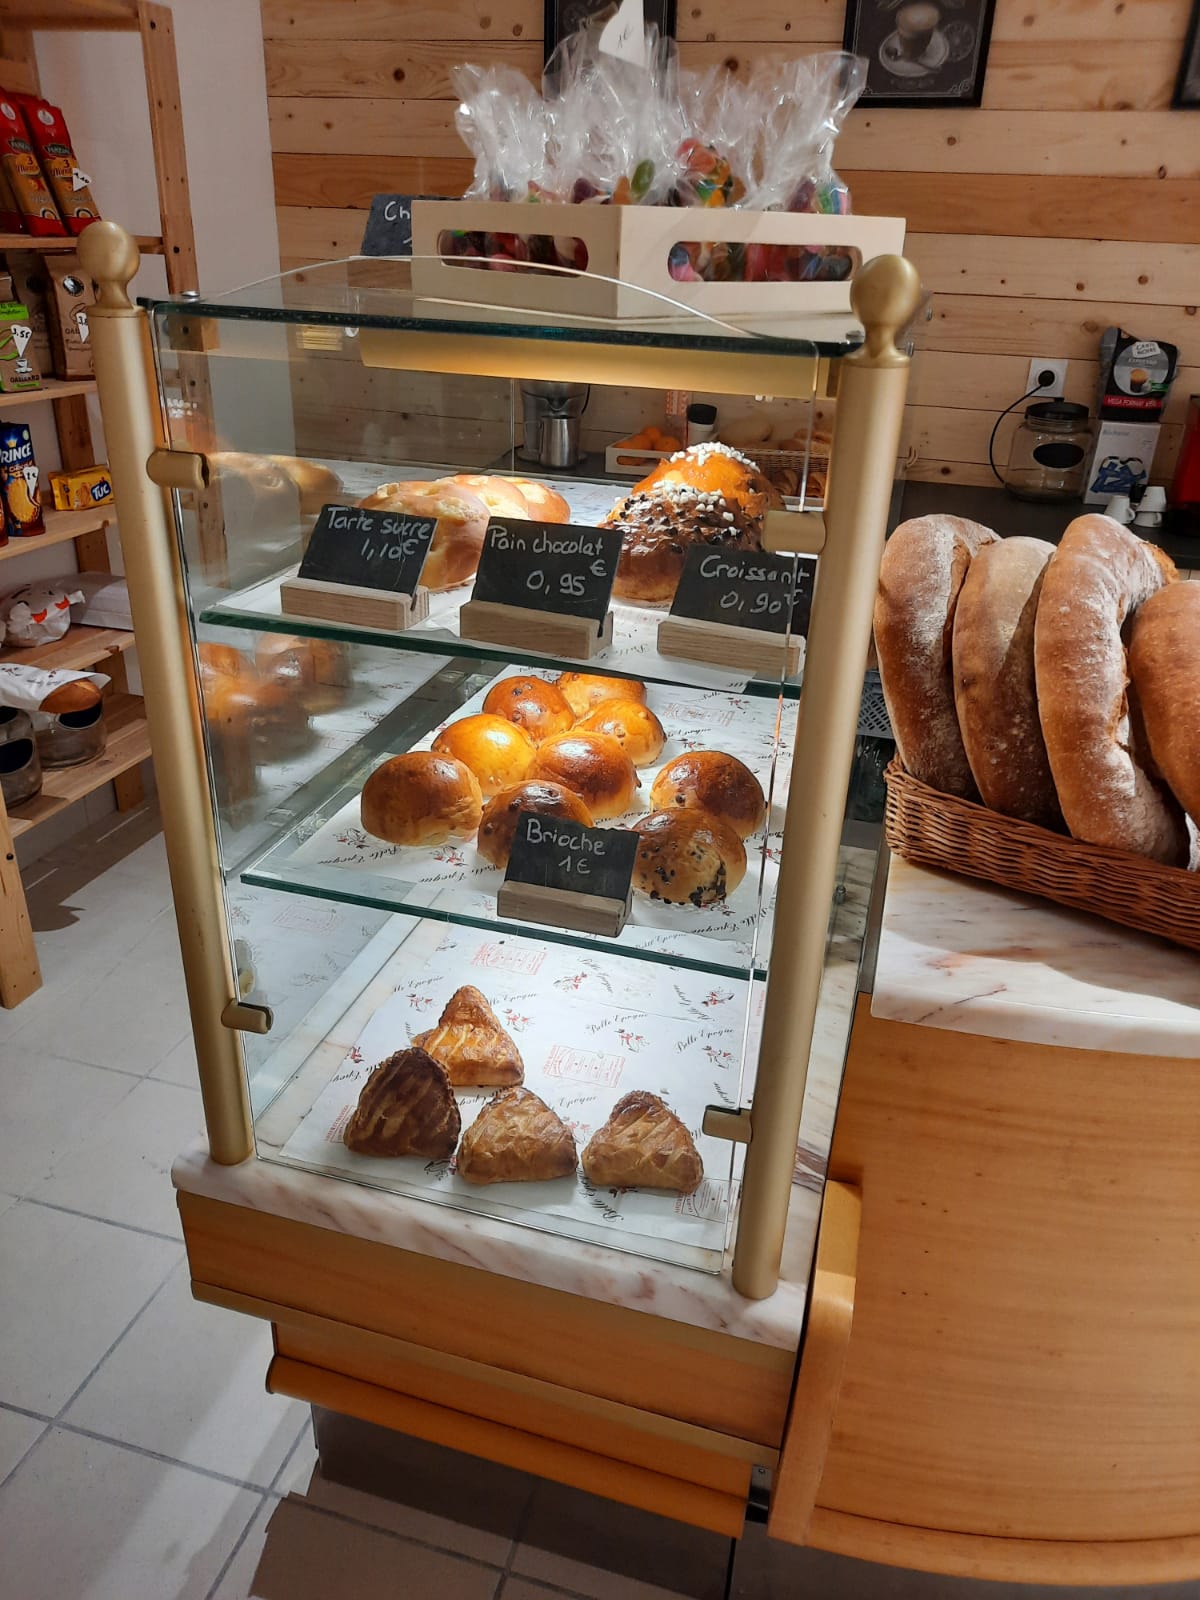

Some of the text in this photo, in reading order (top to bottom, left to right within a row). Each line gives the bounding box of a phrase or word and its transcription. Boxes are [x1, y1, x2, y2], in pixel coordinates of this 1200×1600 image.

[0, 442, 32, 464] RINCE
[327, 506, 432, 541] Tarte sucre
[487, 524, 604, 557] Pain chocolat
[700, 554, 810, 584] Croissant
[526, 817, 606, 856] Brioche
